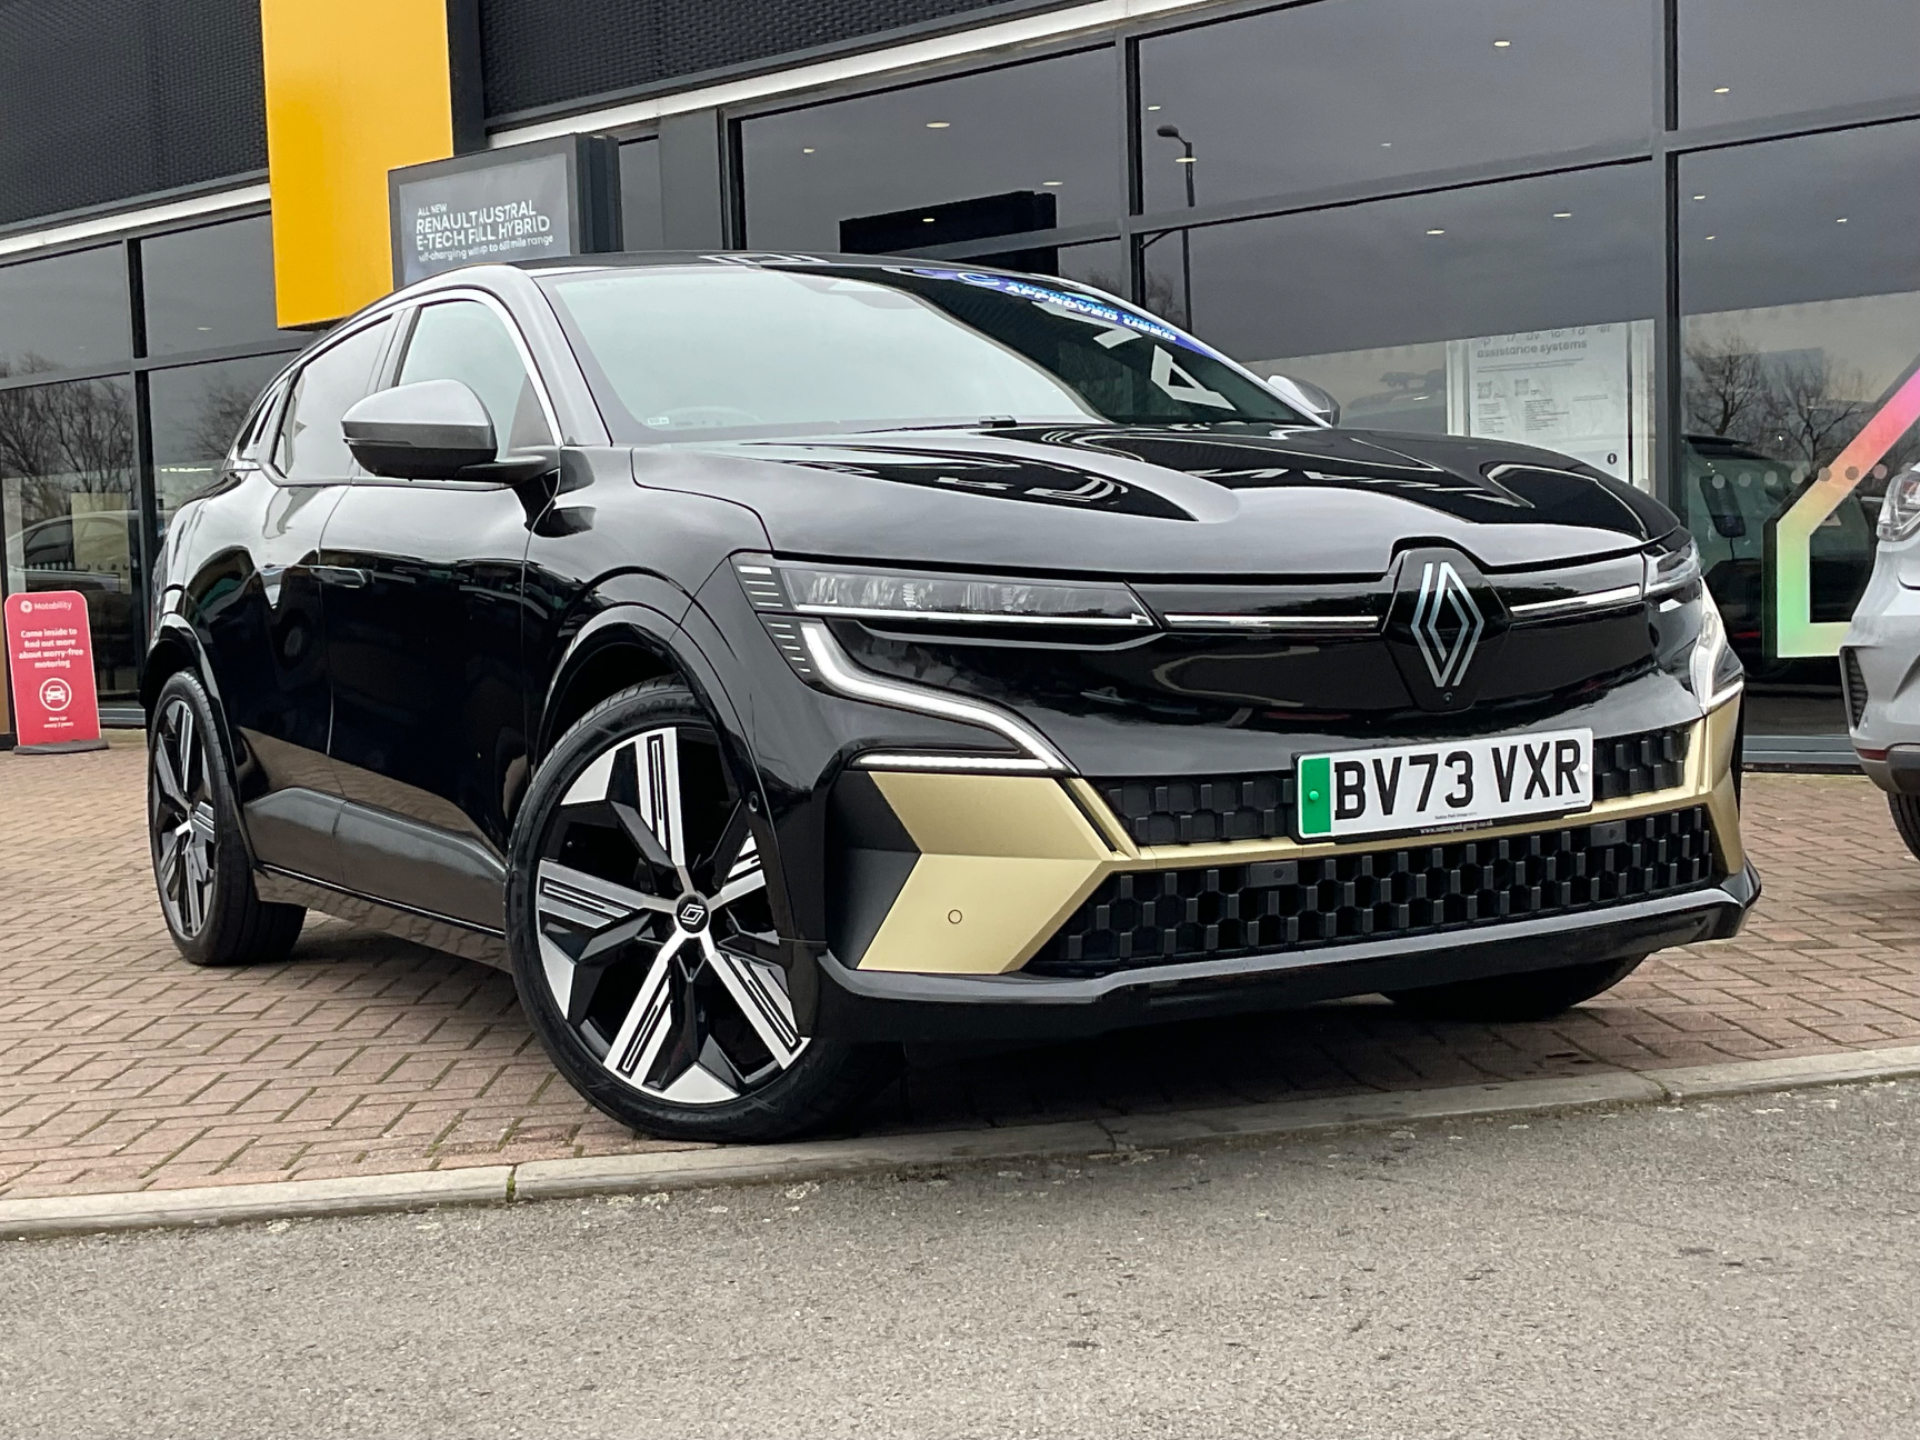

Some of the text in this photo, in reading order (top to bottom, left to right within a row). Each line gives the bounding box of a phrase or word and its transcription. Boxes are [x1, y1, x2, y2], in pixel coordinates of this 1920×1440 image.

[416, 199, 537, 234] RENAULT AUSTRAL
[417, 203, 447, 217] ALL NEW
[416, 229, 466, 250] E-TECH
[498, 215, 551, 239] HYBRID
[488, 242, 498, 252] to
[527, 235, 553, 246] range
[1005, 285, 1177, 341] APPROVED USED
[1477, 340, 1587, 358] assistance systems
[34, 600, 72, 611] Motability
[21, 630, 43, 638] Come
[43, 628, 68, 637] inside
[24, 638, 76, 648] find out more
[19, 647, 84, 660] about worry-free
[34, 659, 71, 668] motoring
[1334, 739, 1580, 820] BV73 VXR
